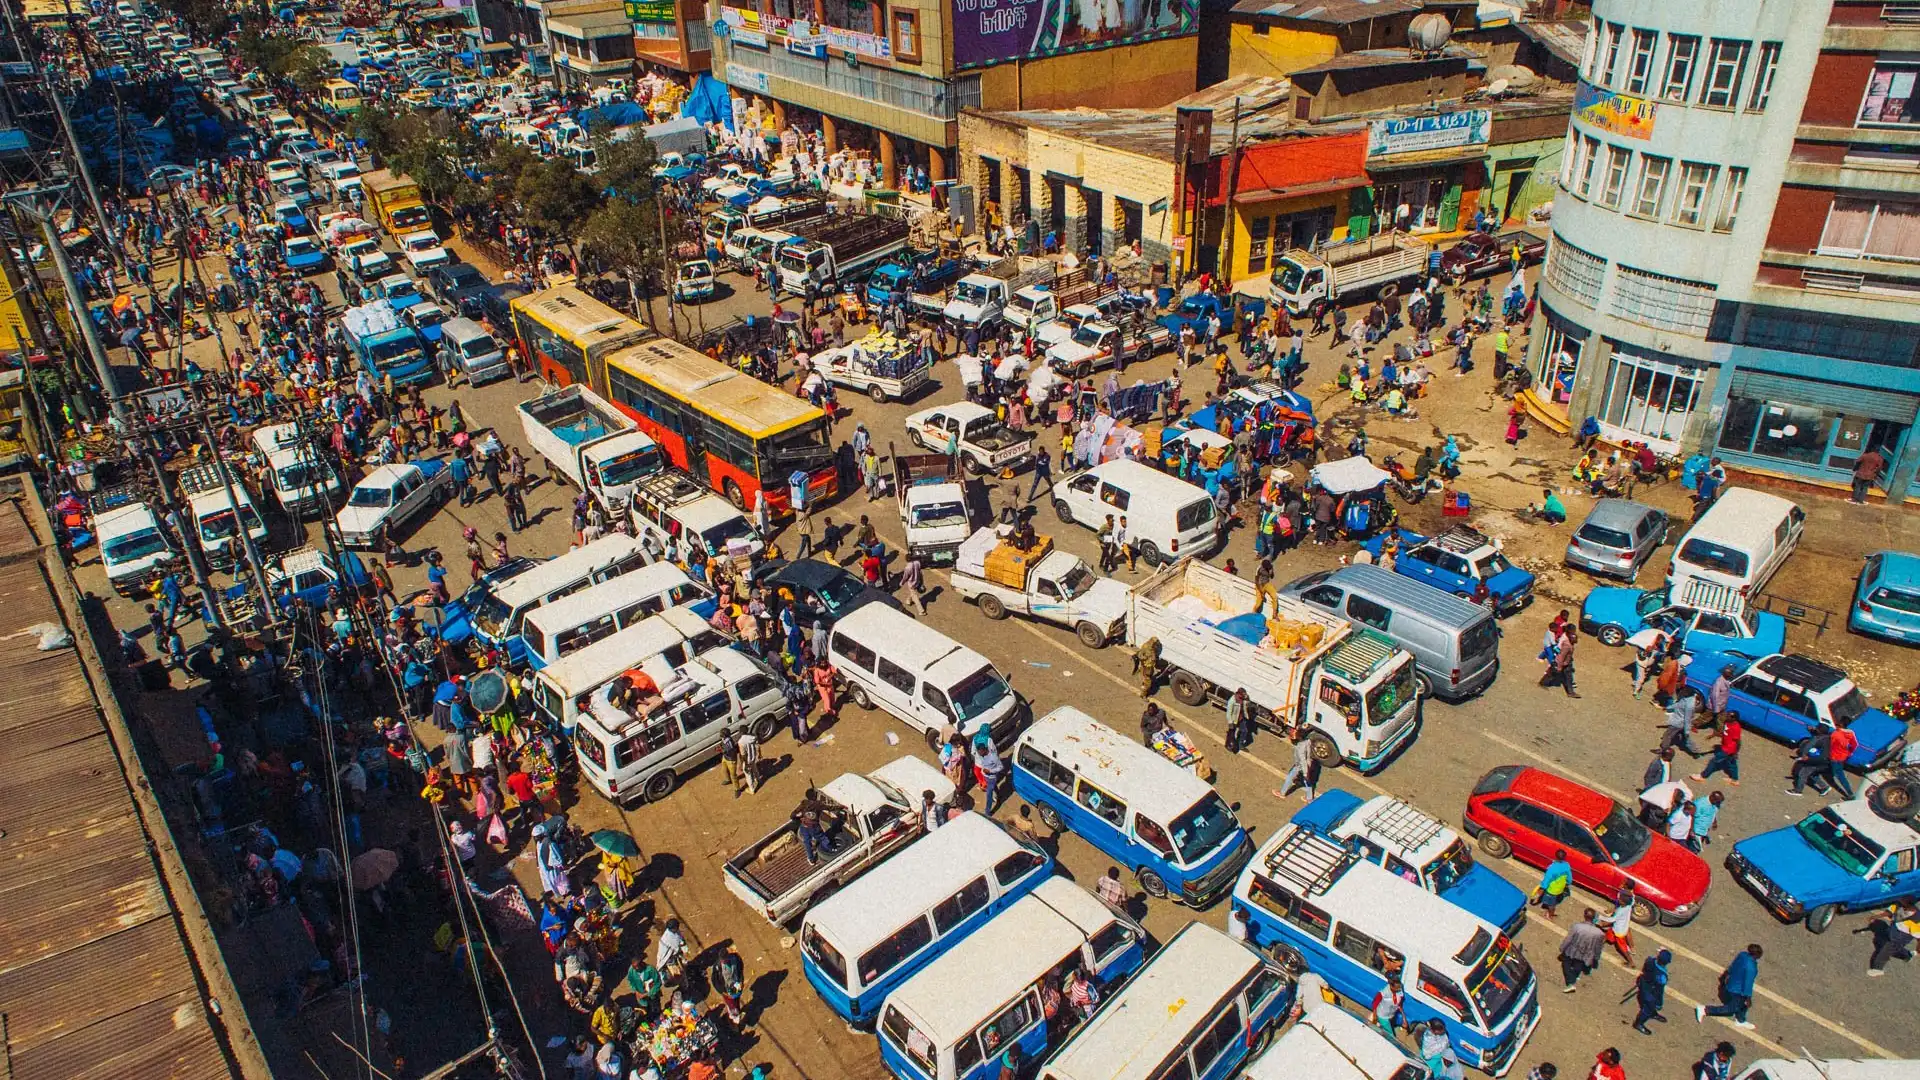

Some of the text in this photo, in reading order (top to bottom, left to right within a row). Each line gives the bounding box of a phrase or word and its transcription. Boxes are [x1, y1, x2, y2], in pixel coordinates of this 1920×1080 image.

[1637, 103, 1657, 120] ቤት
[1394, 112, 1468, 134] ውብ ዲዛይን
[998, 444, 1026, 460] TOYOTA
